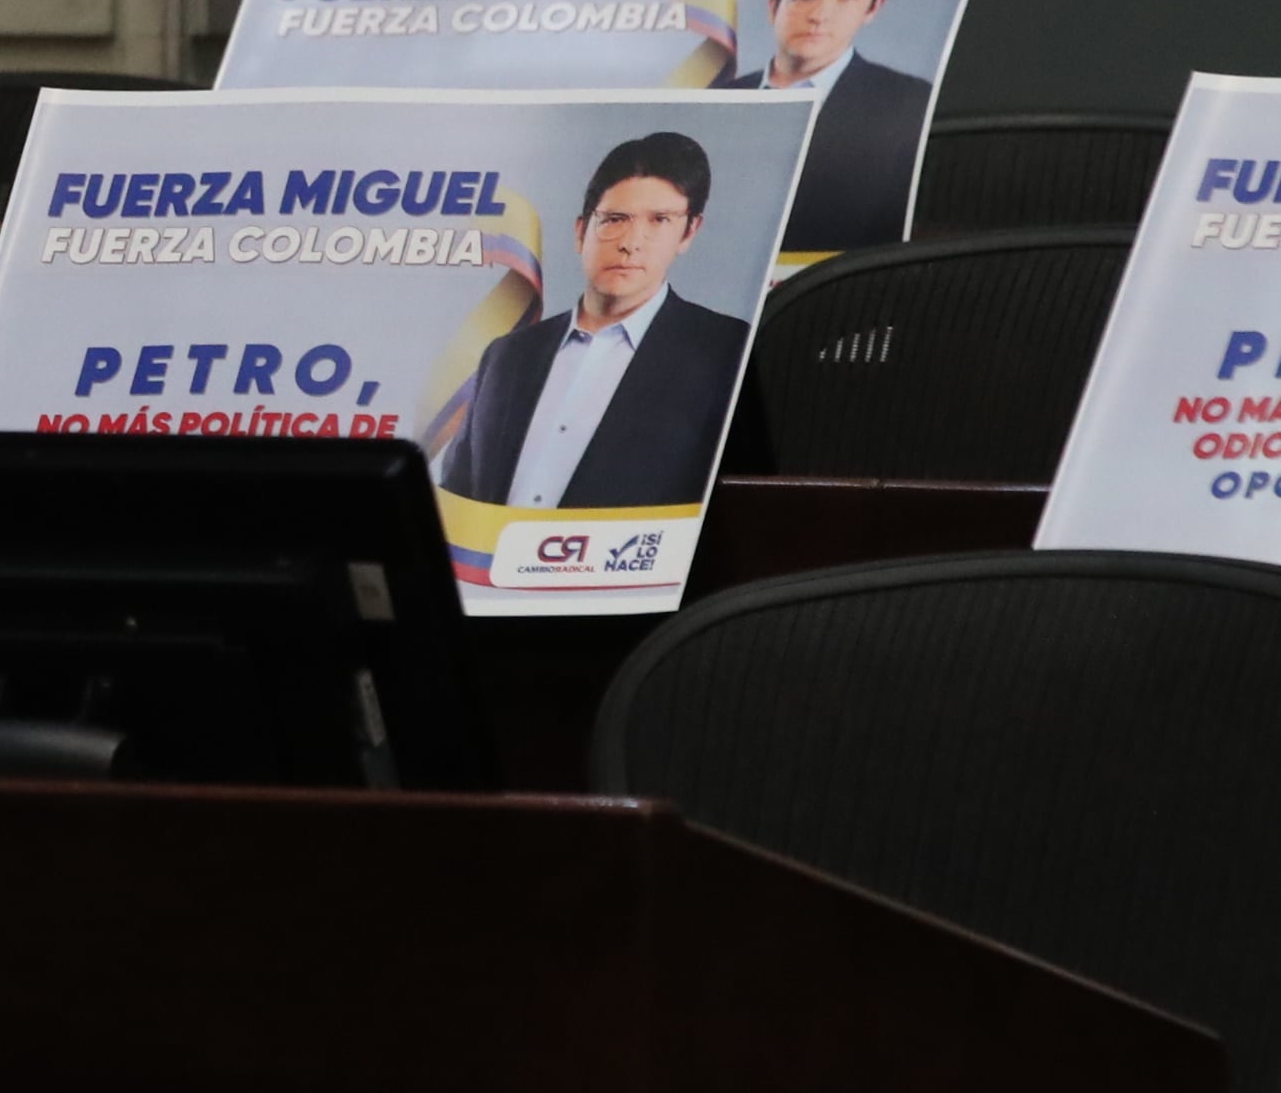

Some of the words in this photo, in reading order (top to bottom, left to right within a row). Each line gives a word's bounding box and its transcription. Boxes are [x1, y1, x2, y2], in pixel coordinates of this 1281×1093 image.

[277, 2, 439, 38] FUERZA
[451, 1, 687, 33] COLOMBIA
[47, 171, 265, 219] FUERZA
[279, 169, 506, 217] MIGUEL
[1195, 159, 1281, 205] FU
[41, 227, 216, 266] FUERZA
[228, 225, 484, 267] COLOMBIA
[74, 343, 380, 406] PETRO,
[37, 414, 90, 434] NO
[98, 405, 173, 435] MÁS
[178, 405, 339, 438] POLÍTICA
[348, 414, 399, 439] DE
[1173, 396, 1232, 424] NO
[1210, 471, 1281, 500] OP
[604, 559, 655, 572] HACE!
[637, 547, 658, 558] LO
